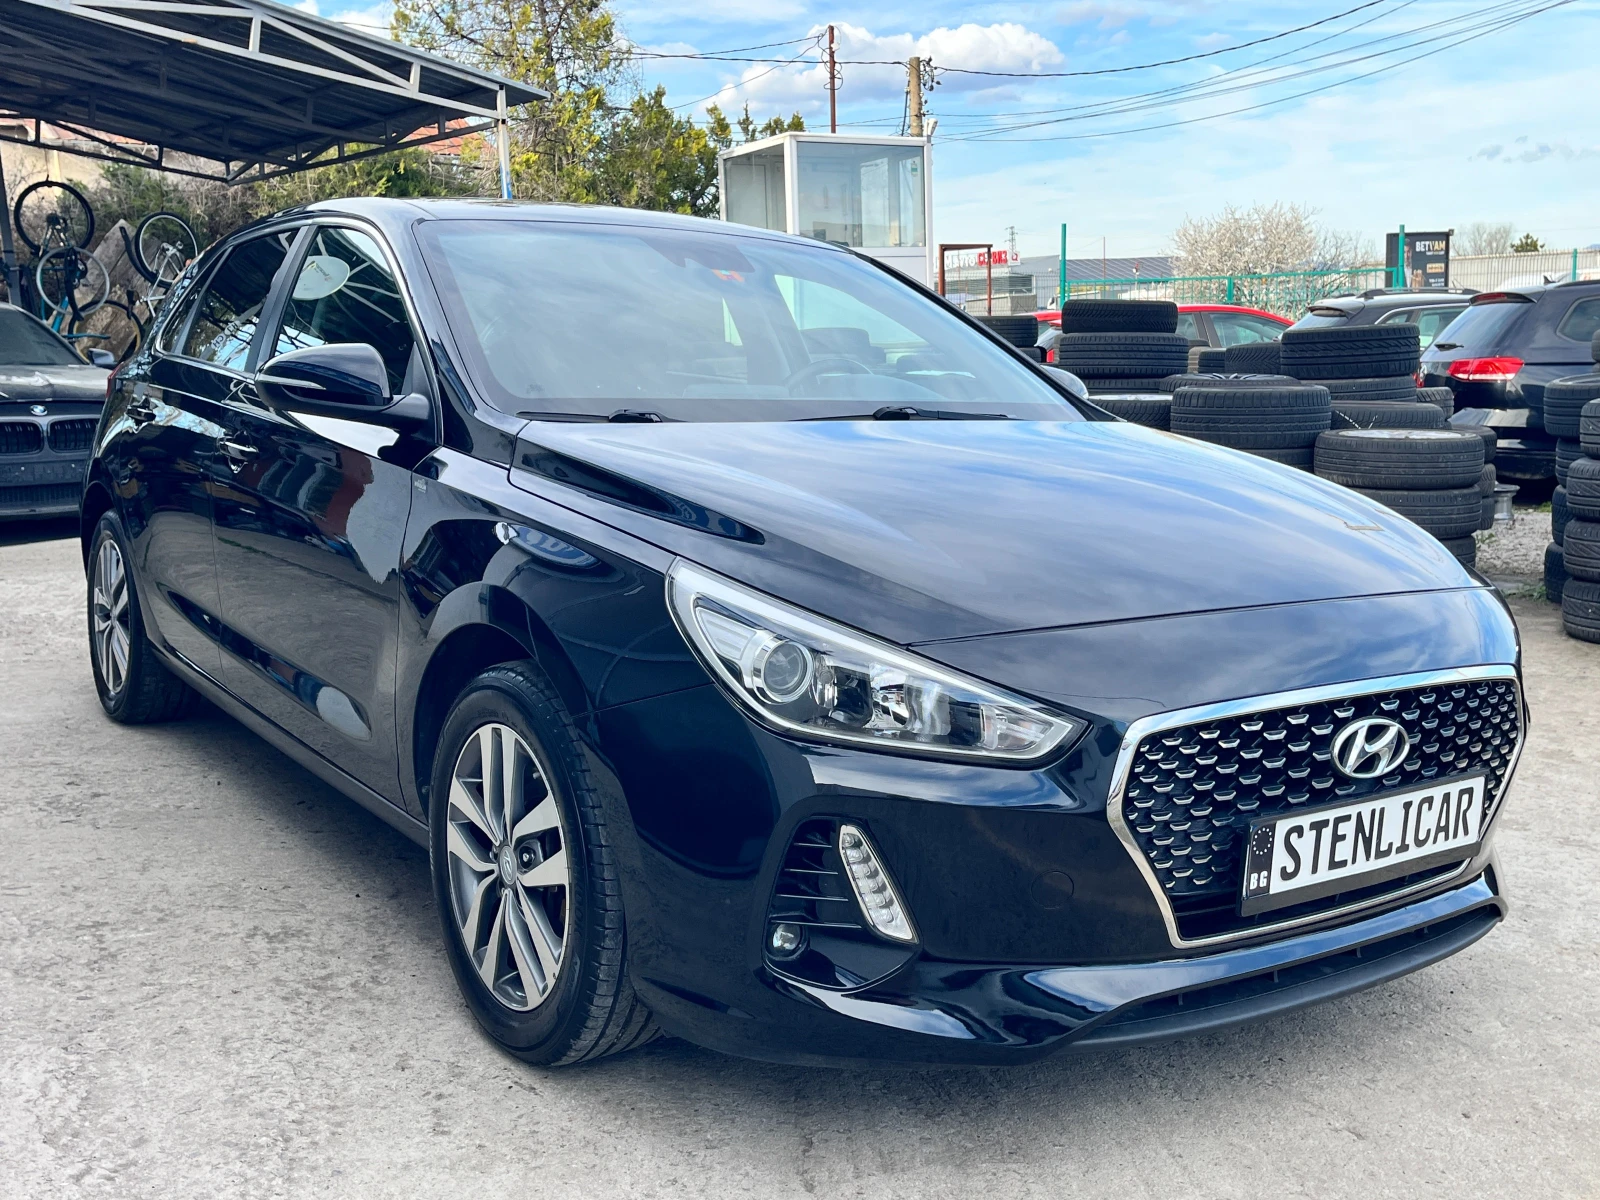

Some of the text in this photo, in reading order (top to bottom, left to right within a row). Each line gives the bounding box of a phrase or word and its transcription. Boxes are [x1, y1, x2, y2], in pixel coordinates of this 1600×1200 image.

[977, 250, 1008, 267] СЕВИЗ
[1279, 786, 1475, 881] STENLICAR
[1249, 870, 1269, 890] BG
